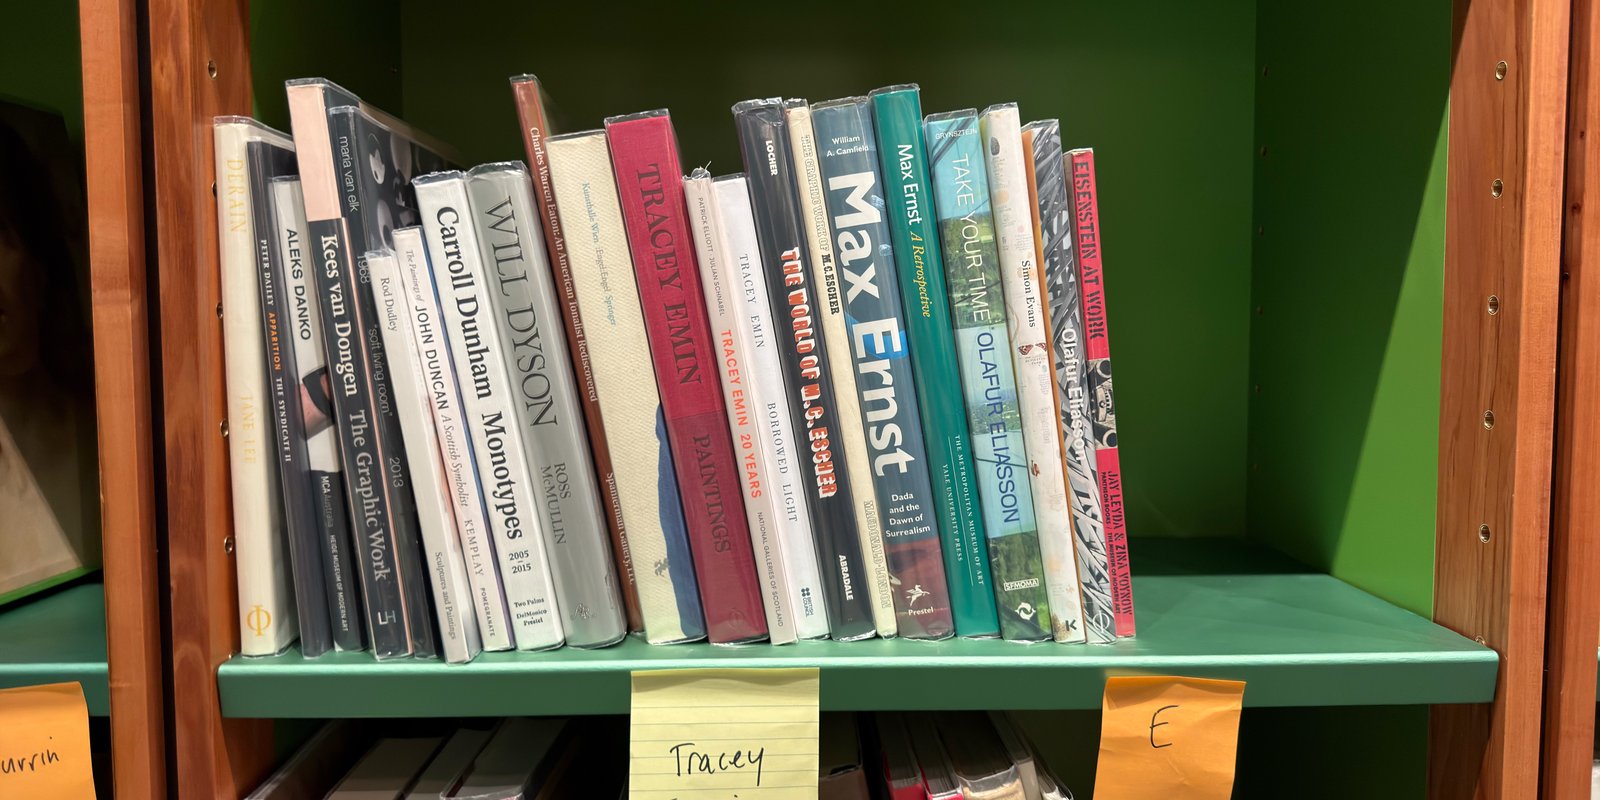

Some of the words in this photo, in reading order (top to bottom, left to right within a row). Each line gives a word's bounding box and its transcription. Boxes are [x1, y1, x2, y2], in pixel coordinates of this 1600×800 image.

[530, 127, 545, 166] Charles
[801, 135, 813, 157] THE
[826, 150, 836, 158] A.
[836, 144, 869, 156] Camfield
[832, 135, 861, 145] William
[935, 127, 978, 140] GRYNSZTEJN
[338, 136, 351, 169] maria
[765, 139, 779, 176] LOCHER
[897, 144, 914, 181] Max
[227, 160, 247, 232] DERAIN
[344, 171, 355, 192] van
[540, 165, 553, 200] Warren
[804, 157, 821, 206] GRAPHIC
[951, 153, 975, 207] TAKE
[347, 194, 360, 212] elk
[547, 203, 561, 236] Eaton:
[698, 197, 708, 226] PATRICK
[903, 183, 923, 226] Ernst
[1075, 162, 1097, 259] EISENSTEIN
[703, 226, 714, 252] ELLIOTT
[813, 206, 828, 237] WORK
[828, 171, 882, 304] Max
[910, 231, 923, 242] A
[260, 239, 270, 269] PETER
[286, 229, 303, 280] ALEKS
[321, 234, 339, 279] Kees
[405, 250, 414, 263] The
[485, 195, 529, 297] WILL
[554, 236, 564, 250] An
[582, 182, 596, 222] Kunsthalle
[591, 222, 600, 243] Wien
[604, 295, 616, 326] Springer
[819, 237, 830, 253] OF
[960, 211, 983, 269] YOUR
[357, 255, 371, 284] 1968
[408, 264, 420, 294] Paintings
[557, 251, 574, 299] American
[635, 163, 684, 291] TRACEY
[664, 302, 702, 385] EMIN
[709, 256, 719, 281] JULIAN
[781, 246, 804, 287] THE
[911, 245, 933, 318] Retrospective
[1021, 260, 1032, 295] Simon
[1083, 265, 1100, 285] AT
[264, 272, 274, 306] DAILEY
[329, 283, 345, 317] van
[380, 277, 393, 297] Rod
[415, 294, 424, 302] of
[713, 281, 725, 316] SCHNABEL
[294, 285, 311, 341] DANKO
[385, 298, 398, 332] Dudley
[415, 305, 434, 344] JOHN
[569, 301, 584, 338] Tonalist
[787, 287, 815, 354] WORLD
[1026, 296, 1036, 328] Evans
[1087, 290, 1105, 340] WORK
[268, 312, 282, 370] APPARITION
[721, 329, 741, 385] TRACEY
[1061, 328, 1079, 384] Olafur
[335, 321, 358, 397] Dongen
[372, 350, 385, 381] living
[436, 206, 475, 291] Carroll
[456, 294, 492, 399] Dunham
[481, 411, 523, 540] Monotypes
[505, 302, 558, 427] DYSON
[577, 339, 598, 402] Rediscovered
[799, 354, 821, 380] OF
[977, 332, 1004, 417] OLAFUR
[276, 377, 285, 397] THE
[426, 349, 449, 410] DUNCAN
[739, 254, 757, 304] TRACEY
[750, 315, 765, 348] EMIN
[768, 402, 789, 474] BORROWED
[783, 483, 798, 522] LIGHT
[852, 317, 915, 477] Ernst
[441, 414, 452, 422] A
[732, 389, 748, 426] EMIN
[1068, 386, 1085, 461] Eliasson
[278, 400, 291, 451] SYNDICATE
[350, 409, 368, 447] The
[443, 424, 461, 461] Scottish
[740, 434, 753, 449] 20
[320, 475, 331, 494] MCA
[355, 451, 382, 527] Graphic
[389, 457, 404, 488] 2013
[450, 462, 469, 507] Symbolist
[554, 462, 571, 499] ROSS
[744, 451, 762, 499] YEARS
[942, 464, 951, 483] YALE
[990, 421, 1020, 523] ELIASSON
[1101, 471, 1109, 502] PANTHEON
[1108, 470, 1120, 490] JAY
[541, 466, 567, 545] McMULLIN
[693, 434, 731, 553] PAINTINGS
[889, 505, 904, 514] and
[906, 502, 920, 512] the
[891, 492, 914, 502] Dada
[946, 486, 959, 535] UNIVERSITY
[954, 434, 962, 452] THE
[958, 454, 973, 517] METROPOLITAN
[968, 520, 979, 554] MUSEUM
[974, 555, 981, 567] OF
[757, 512, 769, 546] NATIONAL
[889, 516, 914, 526] Dawn
[914, 513, 924, 522] of
[1110, 494, 1124, 529] LEYDA
[330, 534, 338, 553] HEIDE
[464, 519, 485, 576] KEMPLAY
[886, 525, 931, 537] Surrealism
[1114, 533, 1124, 541] &
[368, 528, 391, 581] Work
[508, 550, 530, 561] 2005
[764, 545, 775, 579] GALLERIES
[954, 537, 963, 561] PRESS
[1115, 544, 1128, 569] ZINA
[333, 553, 342, 582] MUSEUM
[435, 552, 447, 590] Sculptures
[511, 563, 532, 574] 2015
[770, 580, 777, 590] OF
[839, 554, 854, 601] ABRADALE
[1004, 579, 1039, 591] SFMOMA
[336, 583, 343, 591] OF
[442, 591, 451, 605] and
[514, 601, 527, 609] Two
[527, 597, 545, 606] Palms
[1119, 572, 1133, 615] VOYNOW
[337, 591, 348, 619] MODERN
[445, 605, 457, 640] Paintings
[480, 587, 496, 637] POMEGRANATE
[516, 609, 547, 619] DelMonico
[523, 617, 544, 627] Prestel
[772, 591, 784, 627] SCOTLAND
[908, 606, 934, 616] Prestel
[341, 619, 349, 632] ART
[1149, 705, 1179, 749] E
[669, 742, 764, 787] Tracey
